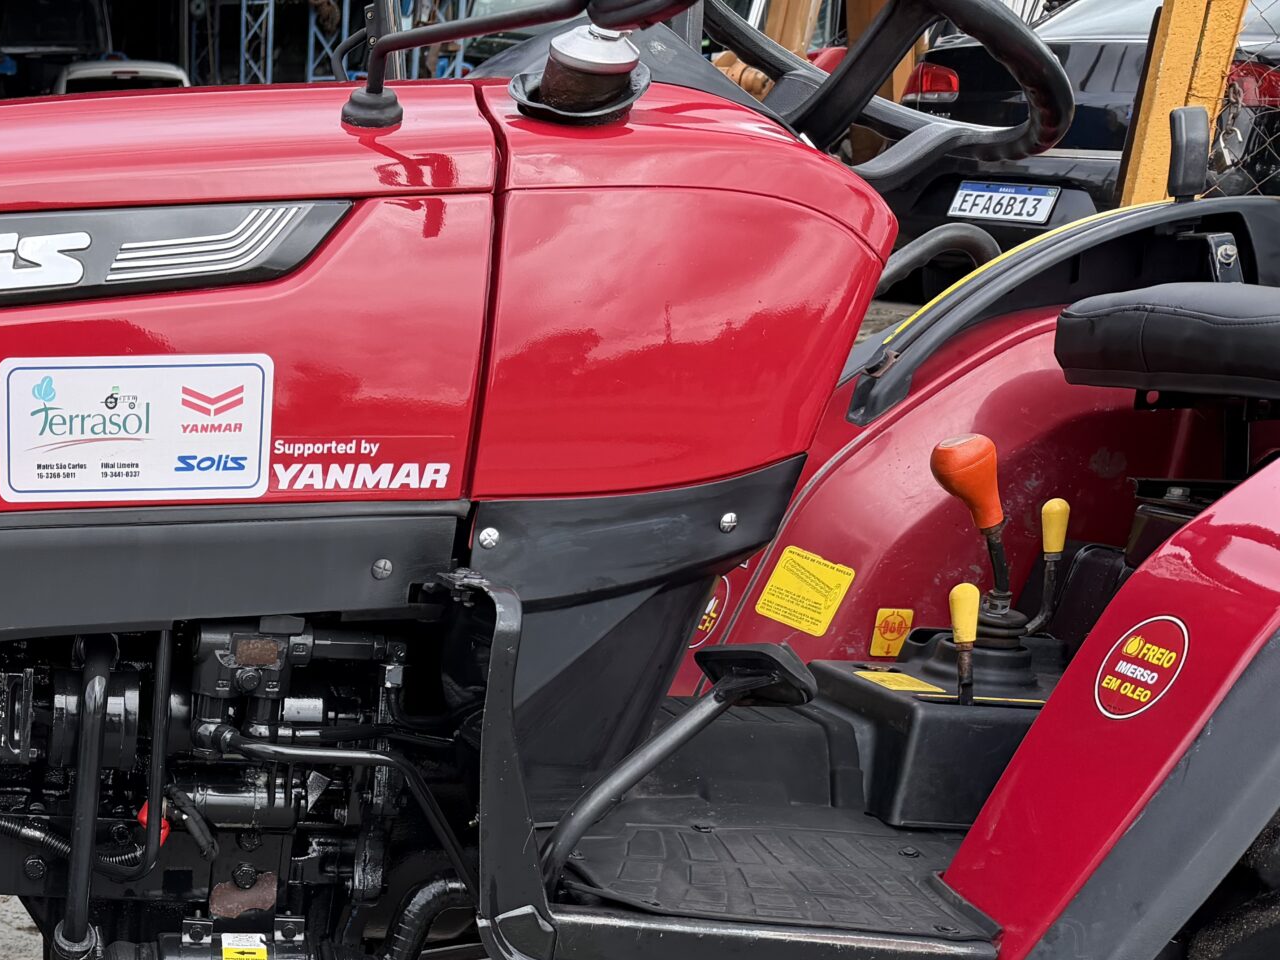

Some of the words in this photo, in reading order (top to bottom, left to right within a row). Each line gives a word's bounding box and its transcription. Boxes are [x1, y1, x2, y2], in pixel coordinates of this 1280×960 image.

[957, 193, 1042, 218] EFA6B13
[30, 402, 150, 436] Terrasol
[181, 422, 243, 434] YANMAR
[273, 439, 356, 457] Supported
[360, 439, 380, 457] by
[67, 462, 87, 470] Carlos
[273, 463, 451, 489] YANMAR
[1138, 643, 1177, 668] FREIO
[1115, 660, 1159, 685] IMERSO
[1101, 674, 1122, 691] EM
[1120, 682, 1152, 703] OLEO
